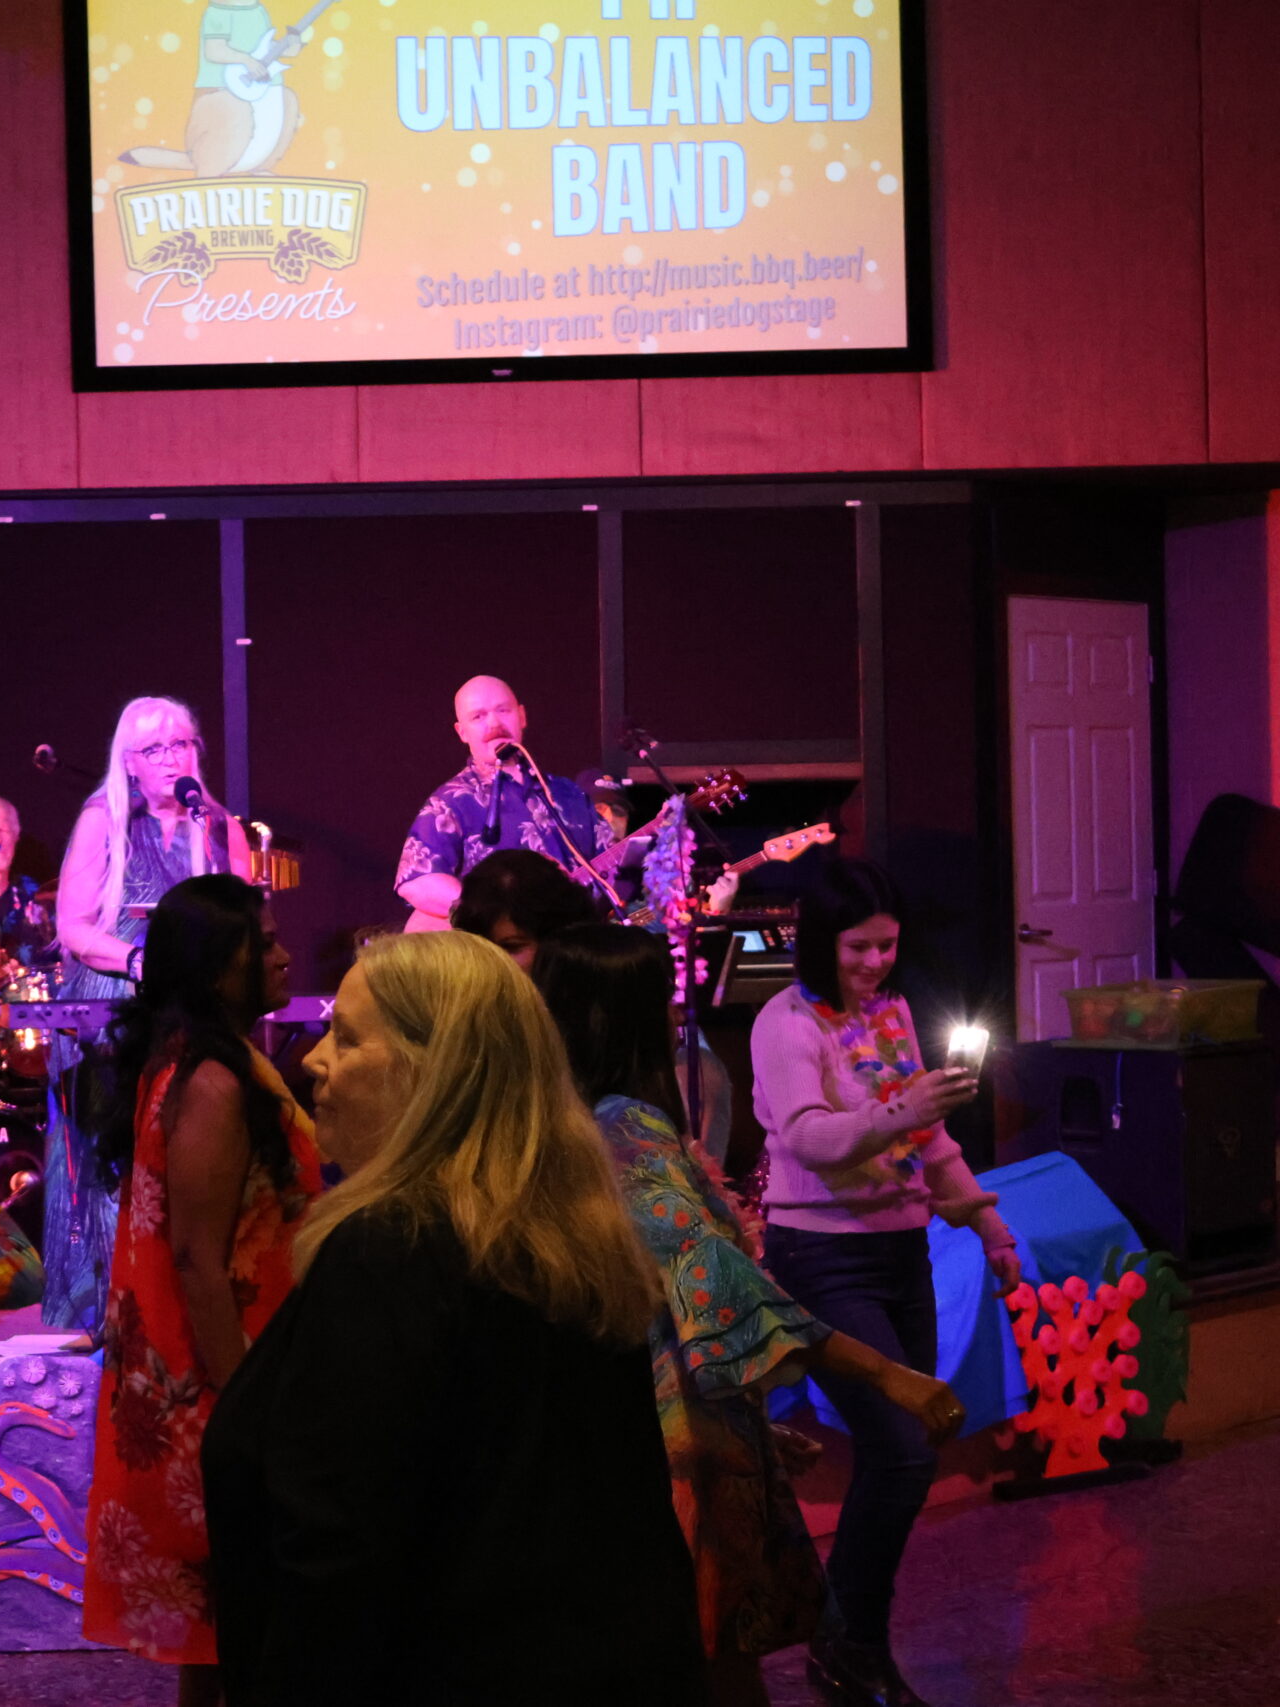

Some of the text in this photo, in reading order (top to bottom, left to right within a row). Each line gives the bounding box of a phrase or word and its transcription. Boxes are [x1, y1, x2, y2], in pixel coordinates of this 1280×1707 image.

[395, 35, 873, 132] UNBALANCED
[129, 187, 353, 236] PRAIRIE DOG
[552, 140, 747, 237] BAND
[210, 229, 274, 248] BREWING
[136, 268, 357, 326] Presents
[417, 246, 864, 308] Schedule at http://music.bbq.beer/
[454, 294, 836, 352] Instagram: @prairiedogstage
